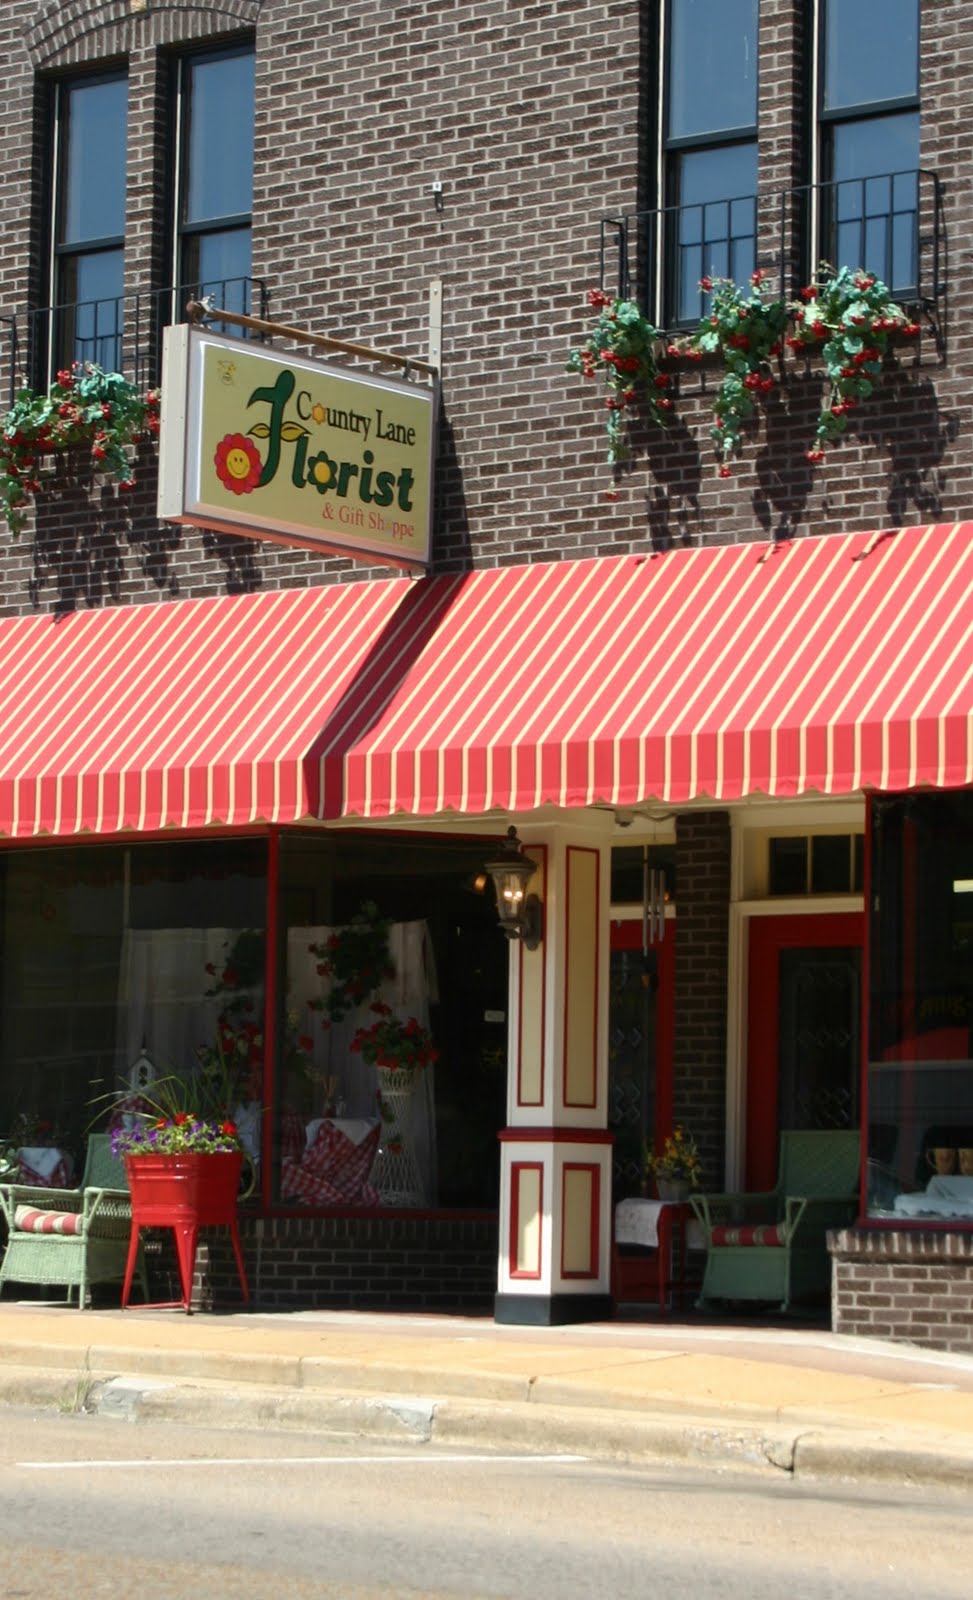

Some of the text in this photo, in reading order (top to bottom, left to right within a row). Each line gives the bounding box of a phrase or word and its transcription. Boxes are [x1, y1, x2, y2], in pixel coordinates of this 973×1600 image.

[246, 369, 415, 512] Florist
[296, 390, 416, 446] Country Lane
[322, 502, 334, 520] &
[339, 506, 364, 526] Gift
